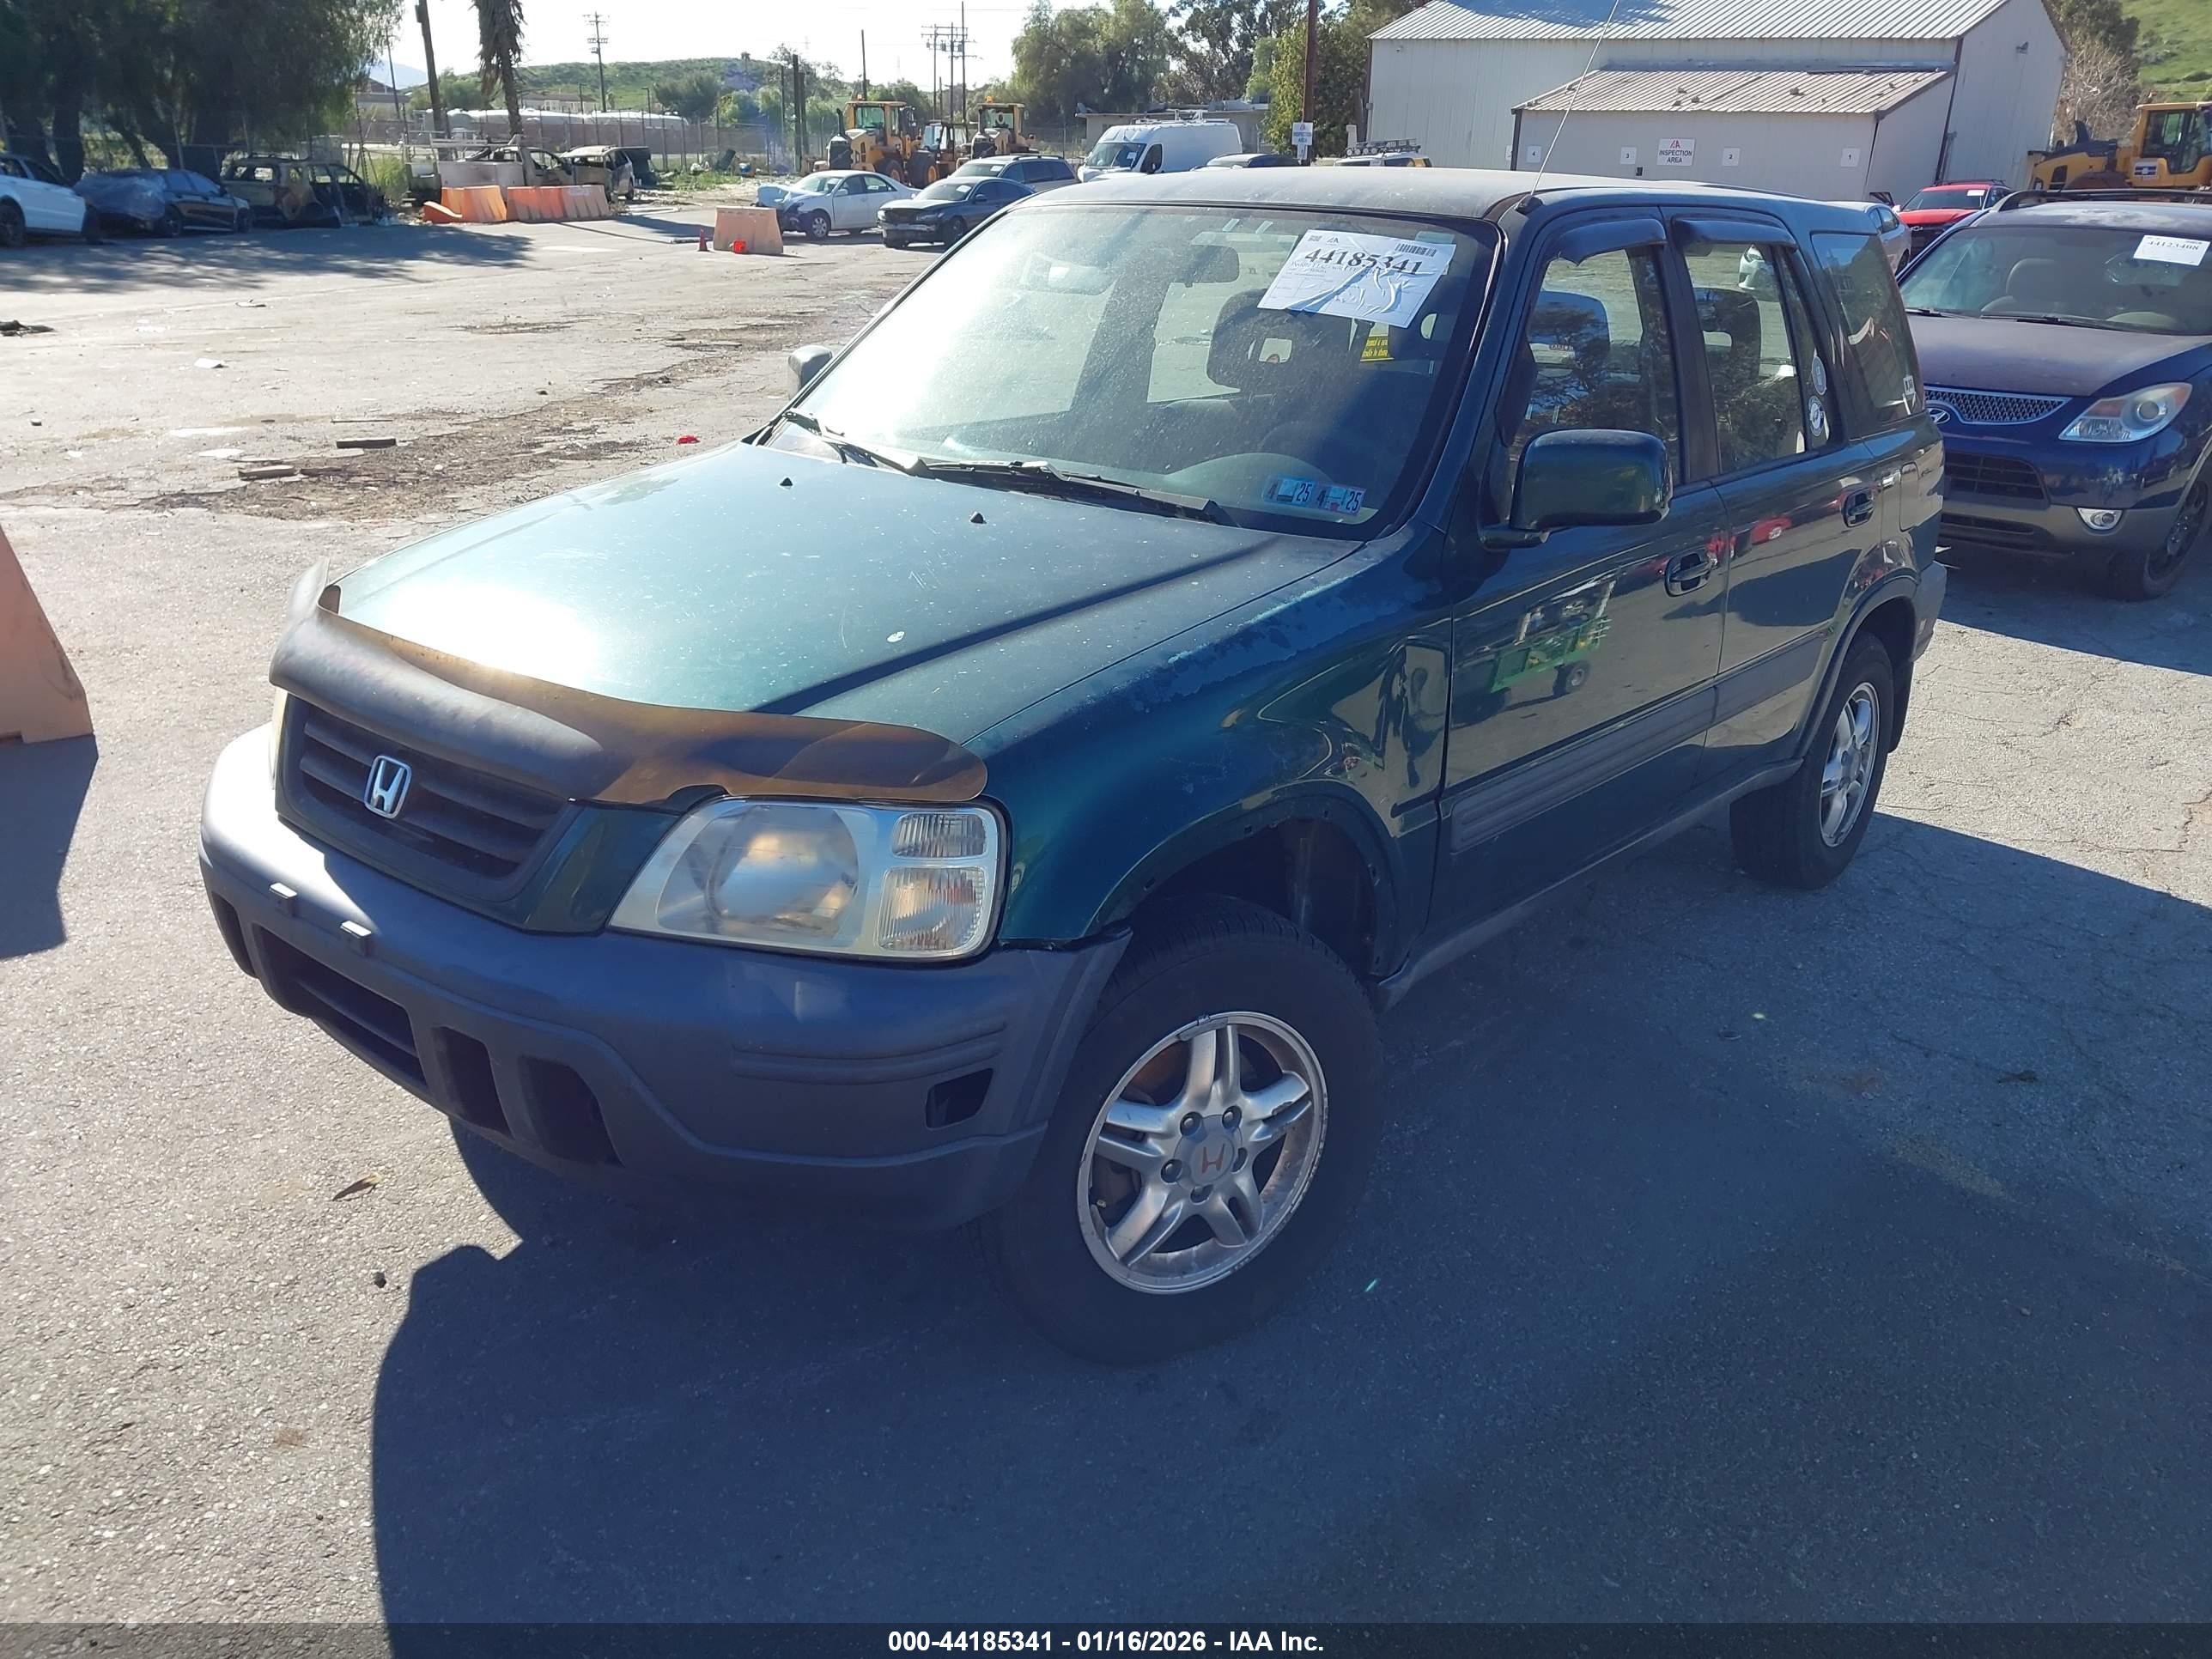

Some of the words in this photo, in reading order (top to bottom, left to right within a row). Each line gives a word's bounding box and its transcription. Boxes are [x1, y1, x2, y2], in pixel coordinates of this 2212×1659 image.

[1304, 248, 1423, 276] 44185341
[1296, 483, 1313, 502] 25
[1346, 490, 1362, 511] 25
